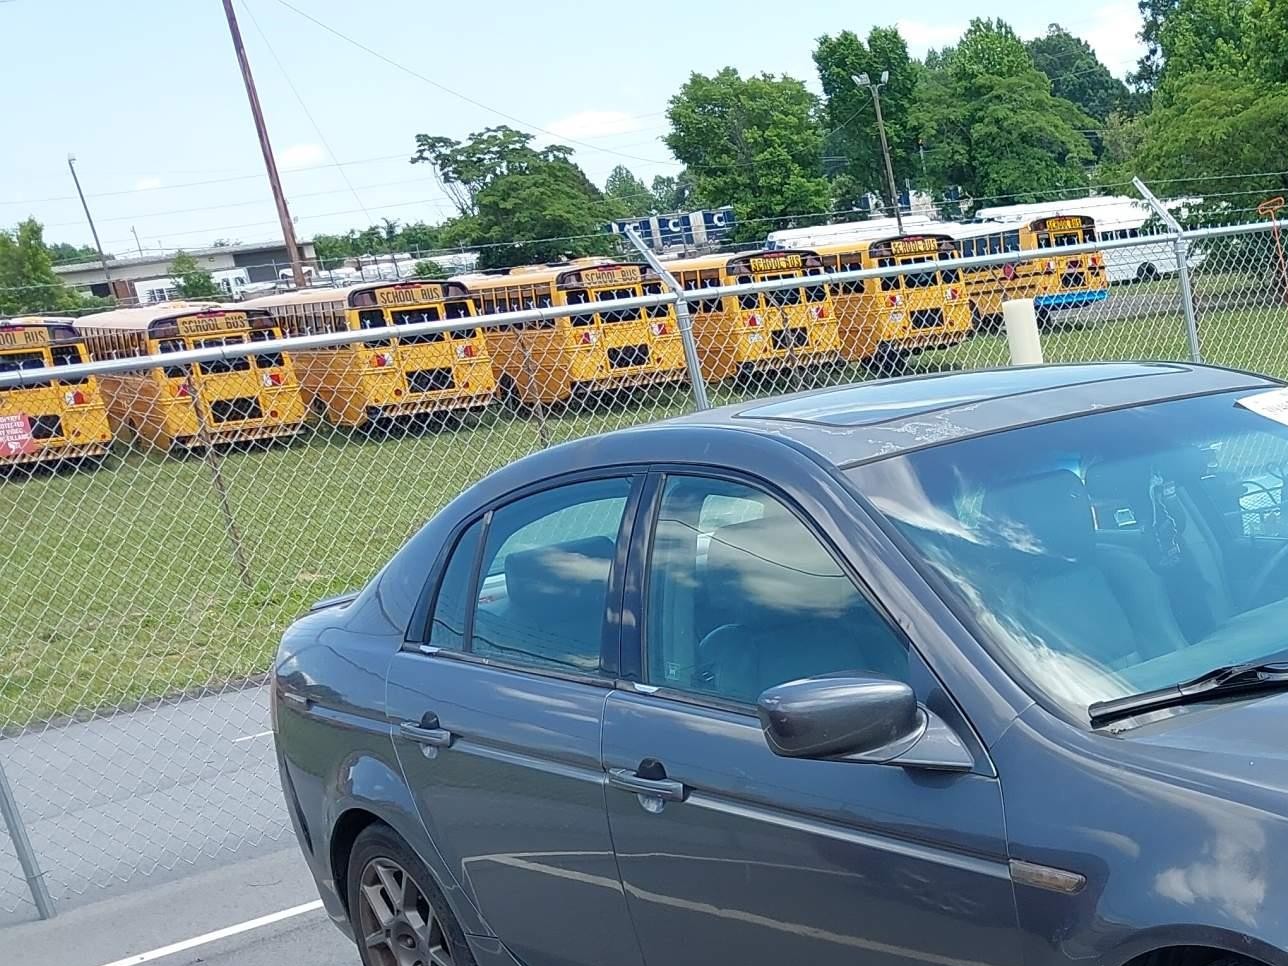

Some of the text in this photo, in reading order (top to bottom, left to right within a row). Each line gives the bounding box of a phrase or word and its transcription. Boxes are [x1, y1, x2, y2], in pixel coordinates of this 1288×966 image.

[752, 257, 785, 271] SCHOOL
[585, 269, 638, 285] SCHOOL BUS
[380, 287, 440, 304] SCHOOL BUS
[182, 315, 246, 334] SCHOOL BUS
[24, 330, 46, 344] BUS
